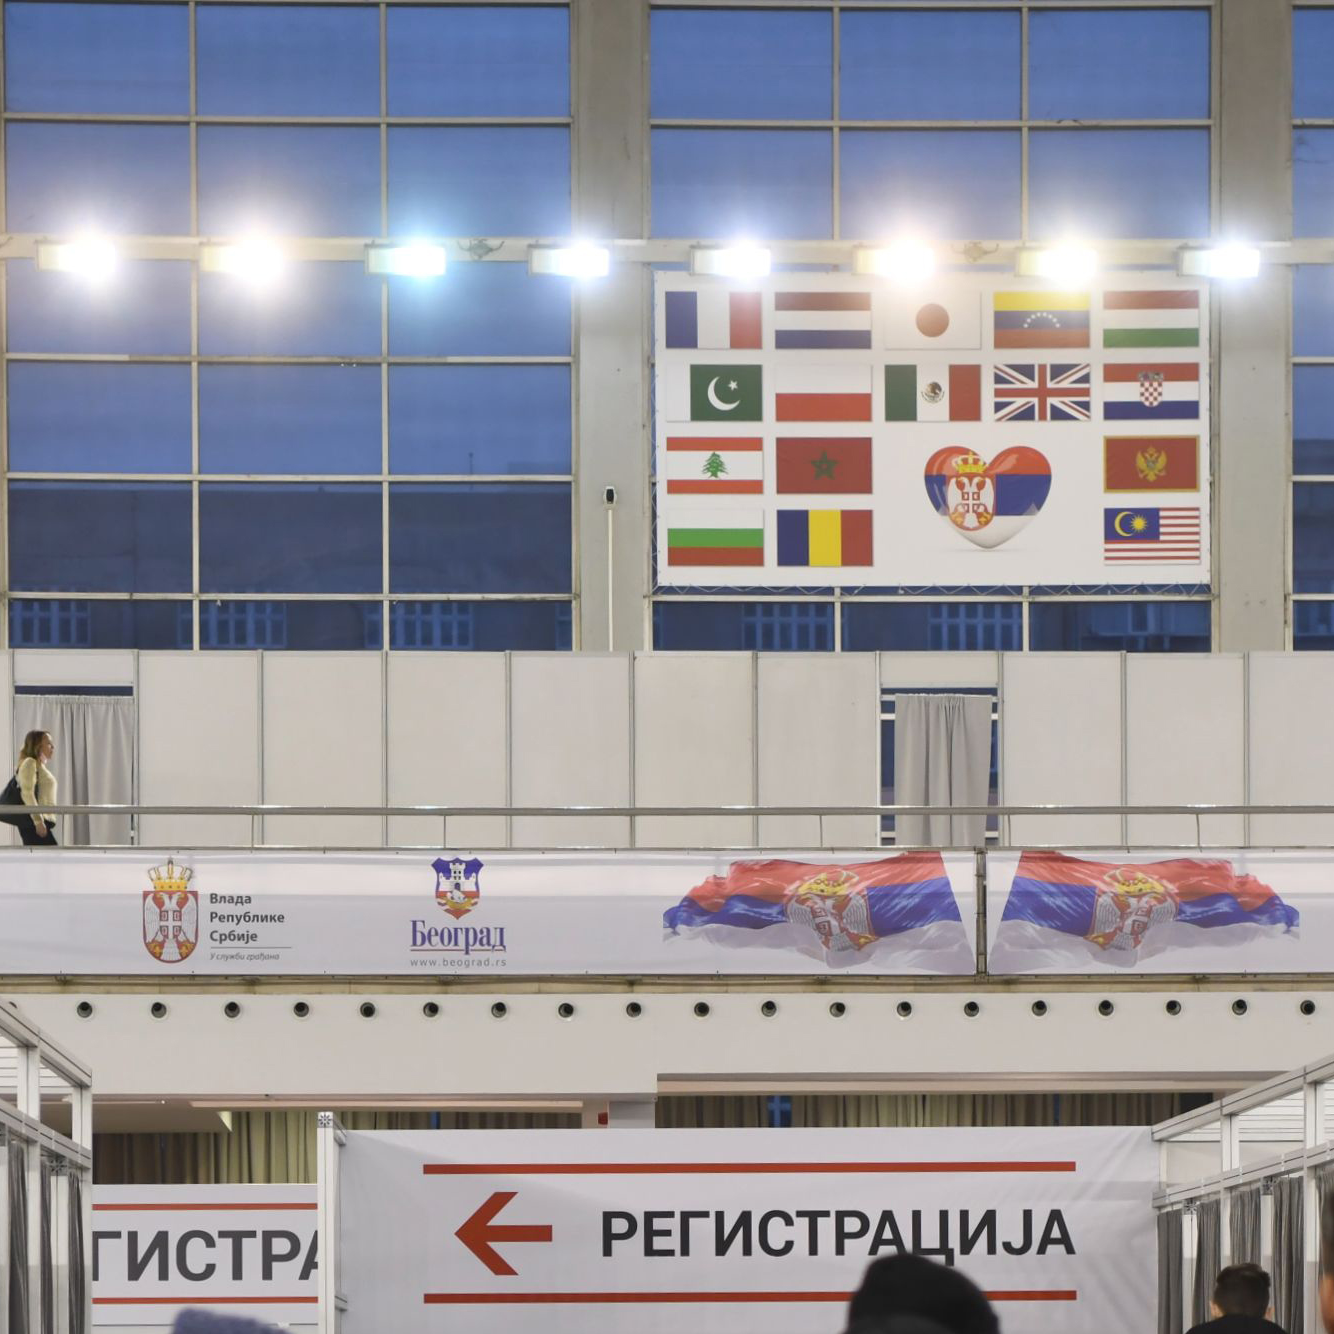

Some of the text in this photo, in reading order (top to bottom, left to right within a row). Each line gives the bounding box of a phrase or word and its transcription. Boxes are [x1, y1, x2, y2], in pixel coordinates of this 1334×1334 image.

[209, 892, 253, 906] Влада
[209, 911, 286, 925] Републике
[209, 930, 259, 944] Србије
[410, 919, 507, 955] Београд
[216, 952, 245, 961] служби
[246, 952, 280, 961] грађана
[410, 958, 507, 968] www.beograd.rs
[601, 1208, 1077, 1267] РЕГИСТРАЦИЈА
